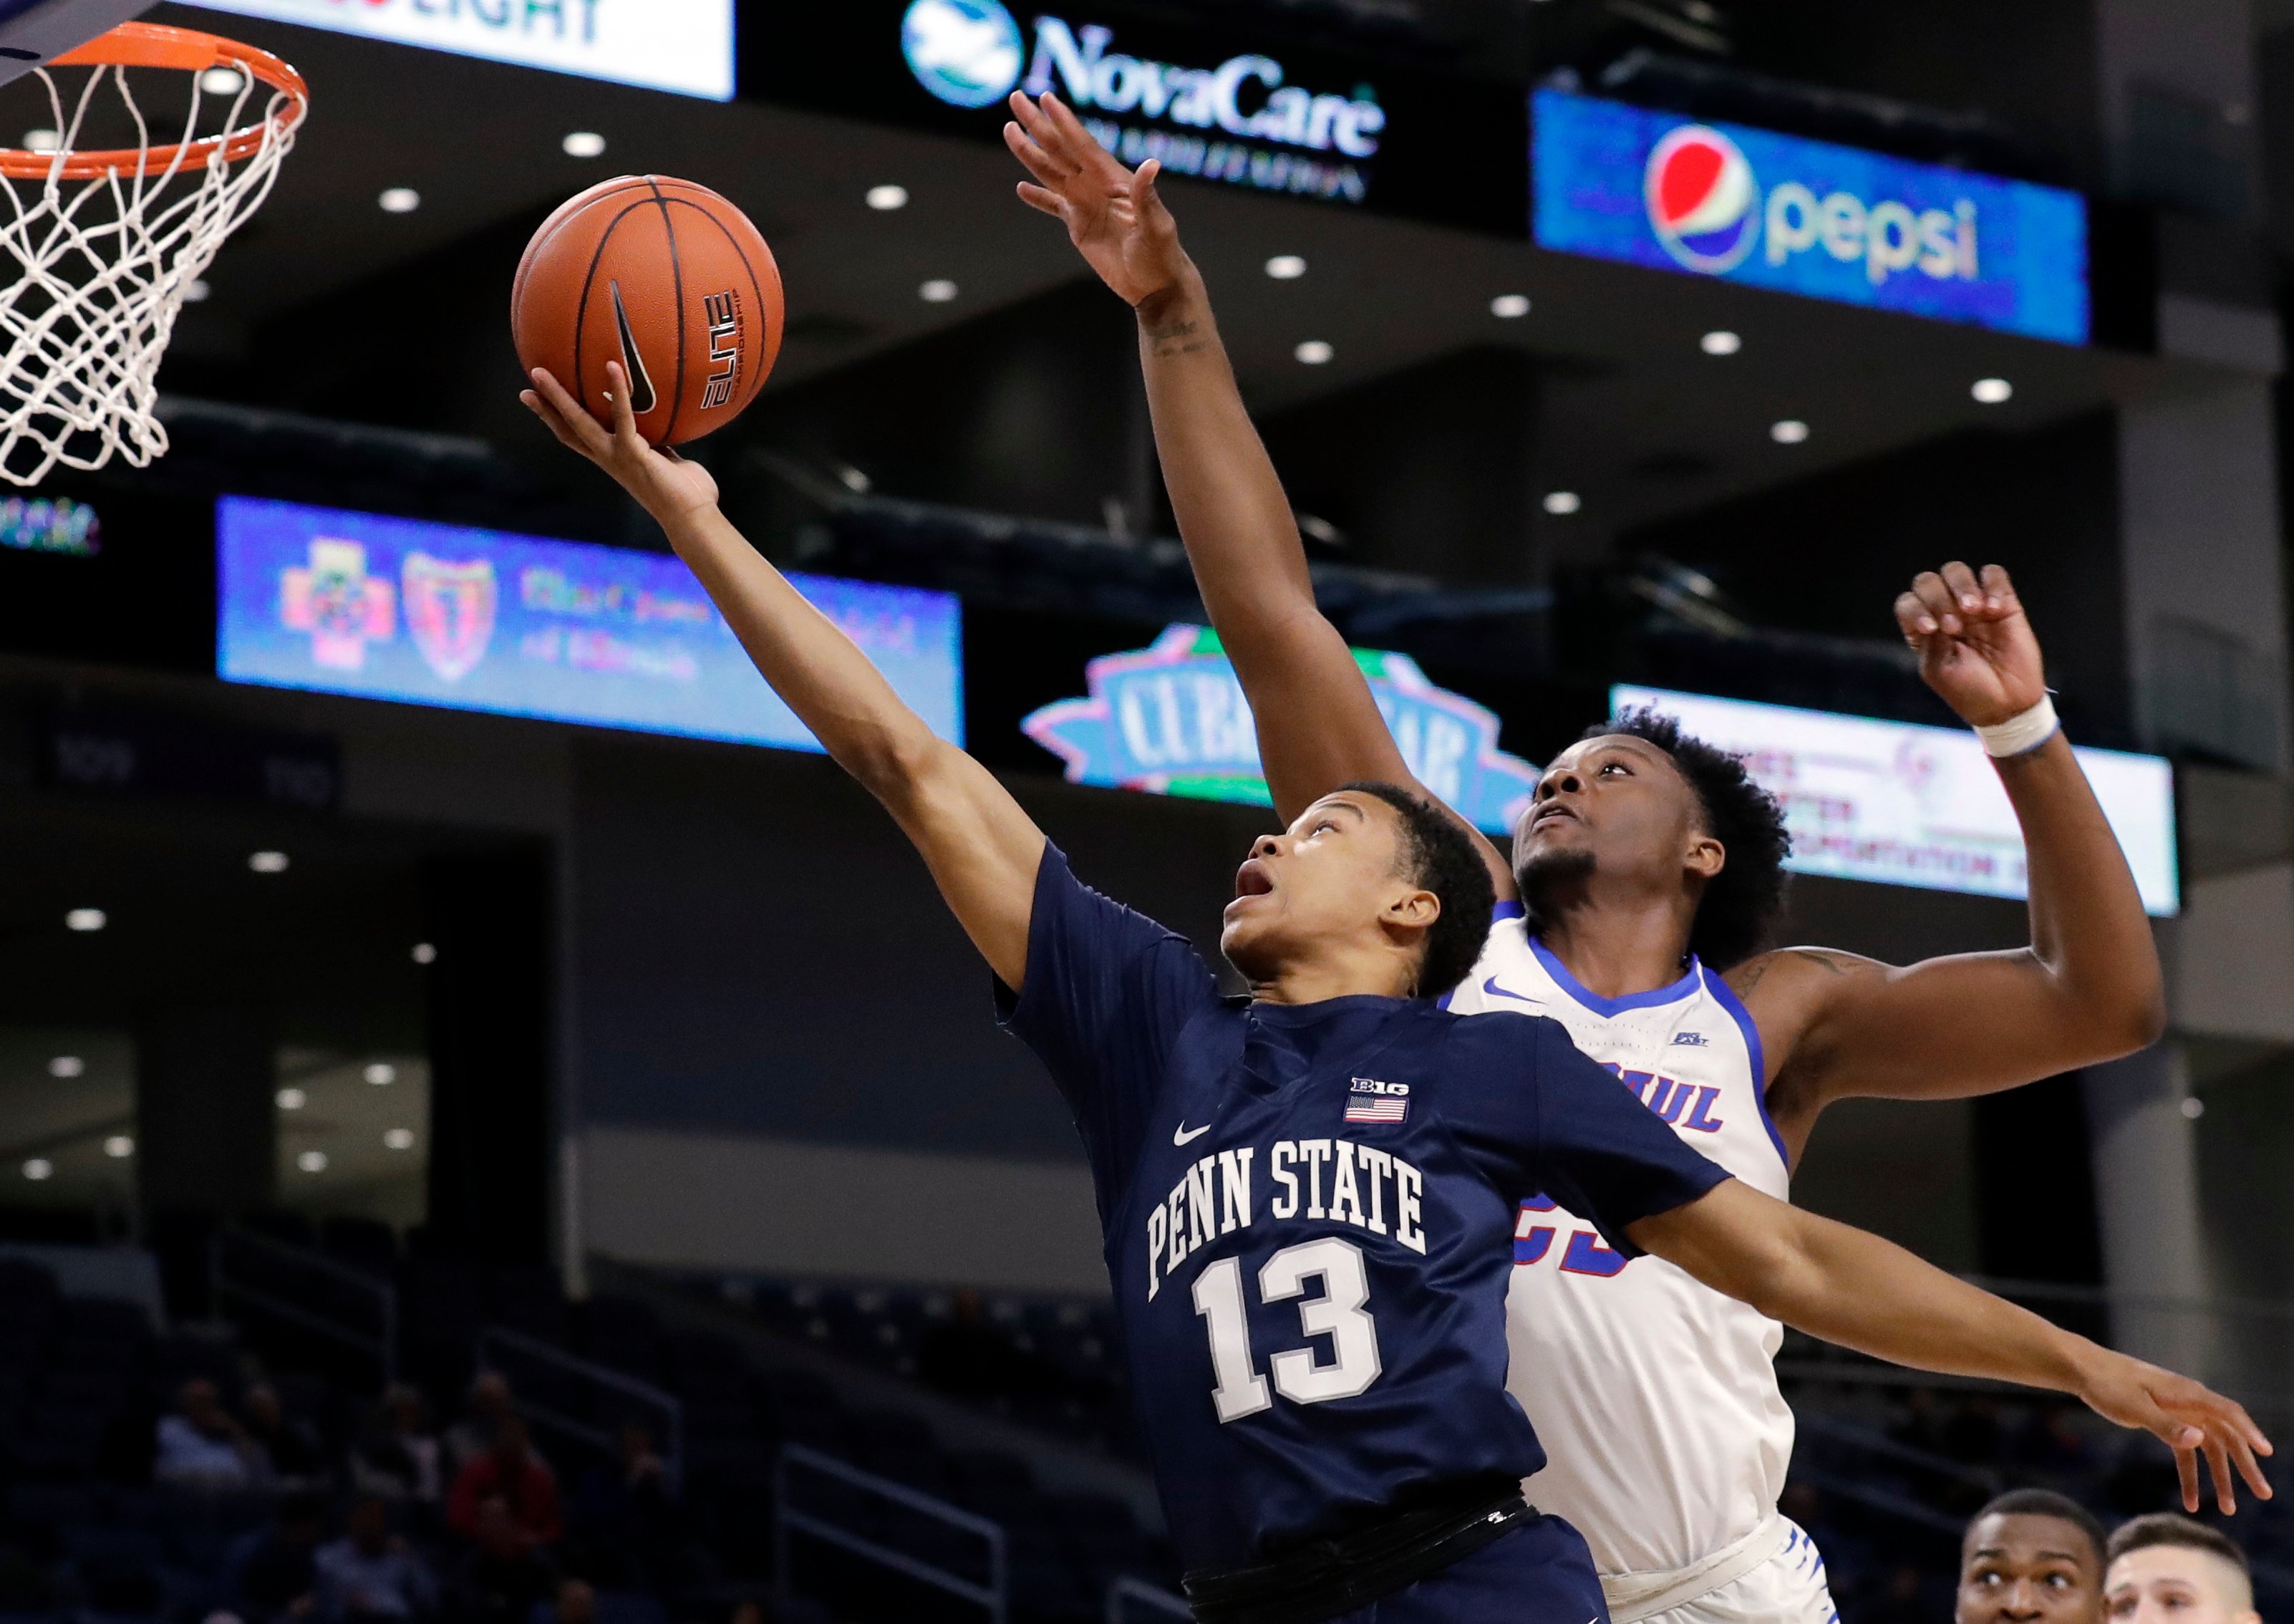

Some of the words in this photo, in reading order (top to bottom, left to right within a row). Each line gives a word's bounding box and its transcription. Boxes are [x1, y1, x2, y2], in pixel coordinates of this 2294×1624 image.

[410, 0, 597, 44] GHT
[1022, 14, 1386, 158] NovaCare
[1765, 180, 1980, 284] pepsi
[700, 291, 737, 410] ELITE
[729, 288, 745, 402] CHAMPIONSHIP
[1147, 1148, 1254, 1303] PENN
[1271, 1139, 1427, 1255] STATE
[1191, 1237, 1383, 1424] 13
